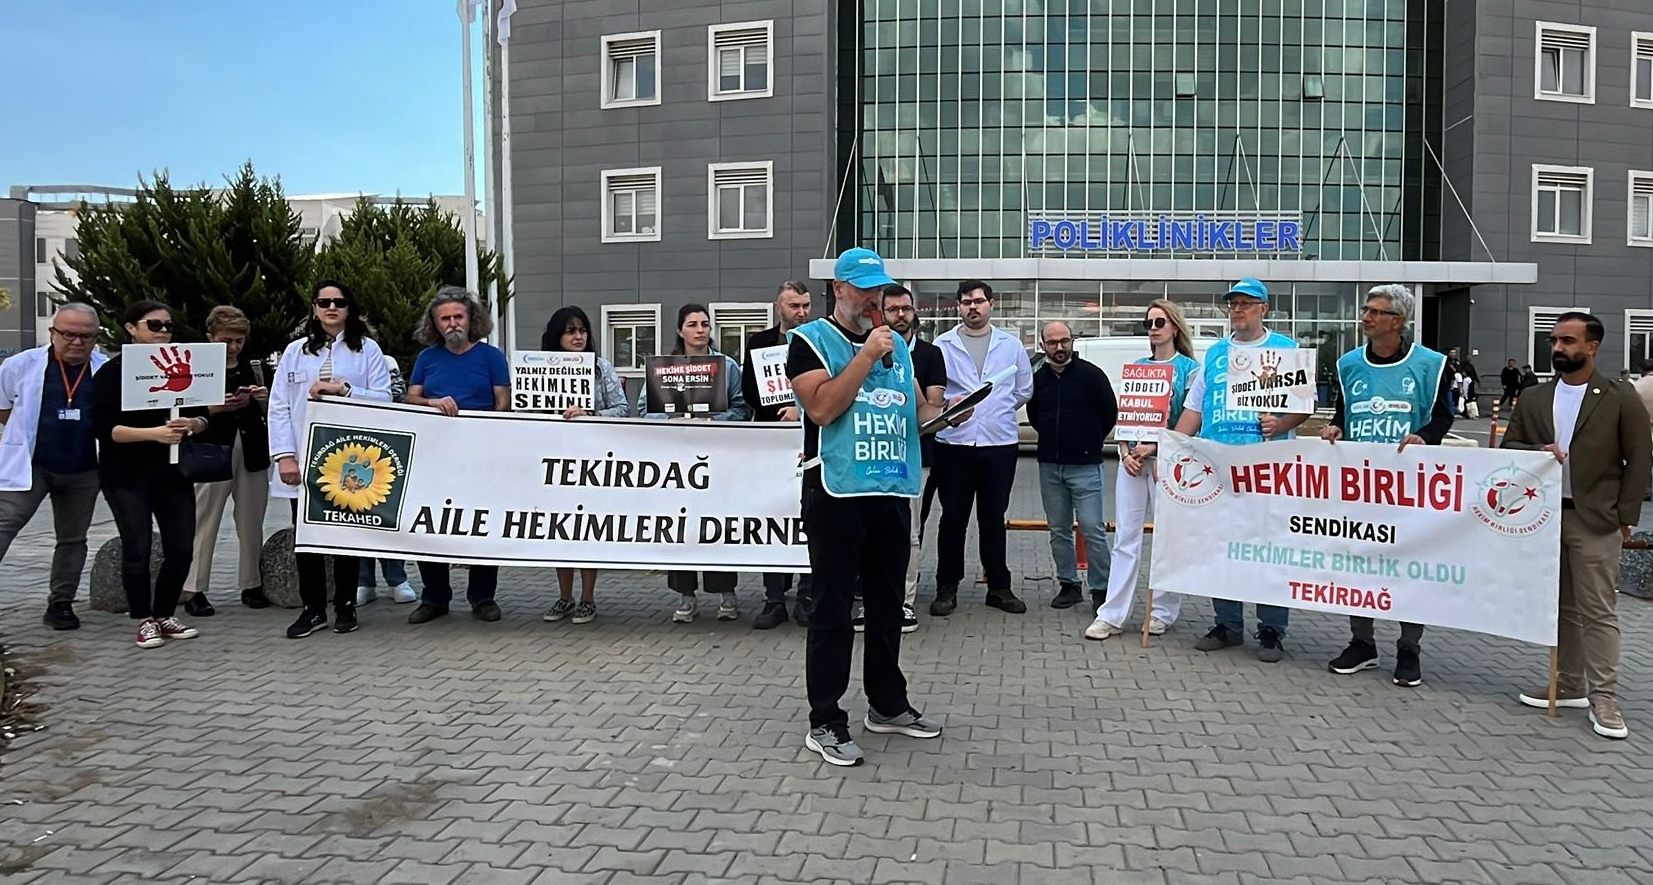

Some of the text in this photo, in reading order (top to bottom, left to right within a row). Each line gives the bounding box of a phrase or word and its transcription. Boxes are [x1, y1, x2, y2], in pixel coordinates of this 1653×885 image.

[1031, 213, 1299, 250] POLİKLİNİKLER
[515, 366, 592, 376] YALNIZ DEĞİLSİN
[656, 366, 685, 375] HEKİME
[685, 375, 709, 383] ERSİN
[1123, 367, 1167, 378] SAĞLIKTA
[516, 376, 591, 395] HEKİMLER
[1124, 381, 1164, 393] ŞİDDETİ
[1231, 369, 1308, 394] ŞİDDET VARSA
[515, 393, 592, 408] SENİNLE
[1120, 398, 1154, 408] KABUL
[1237, 395, 1249, 406] BİZ
[1250, 394, 1288, 408] YOKUZ
[1350, 416, 1411, 439] HEKİM
[541, 451, 710, 490] TEKİRDAĞ
[1230, 455, 1464, 512] HEKİM BİRLİĞİ
[322, 510, 382, 526] TEKAHED
[409, 498, 808, 546] AİLE HEKİMLERİ DERNE
[1289, 515, 1396, 544] SENDİKASI
[1227, 541, 1466, 585] HEKİMLER BİRLİK OLDU
[1289, 581, 1392, 611] TEKİRDAĞ
